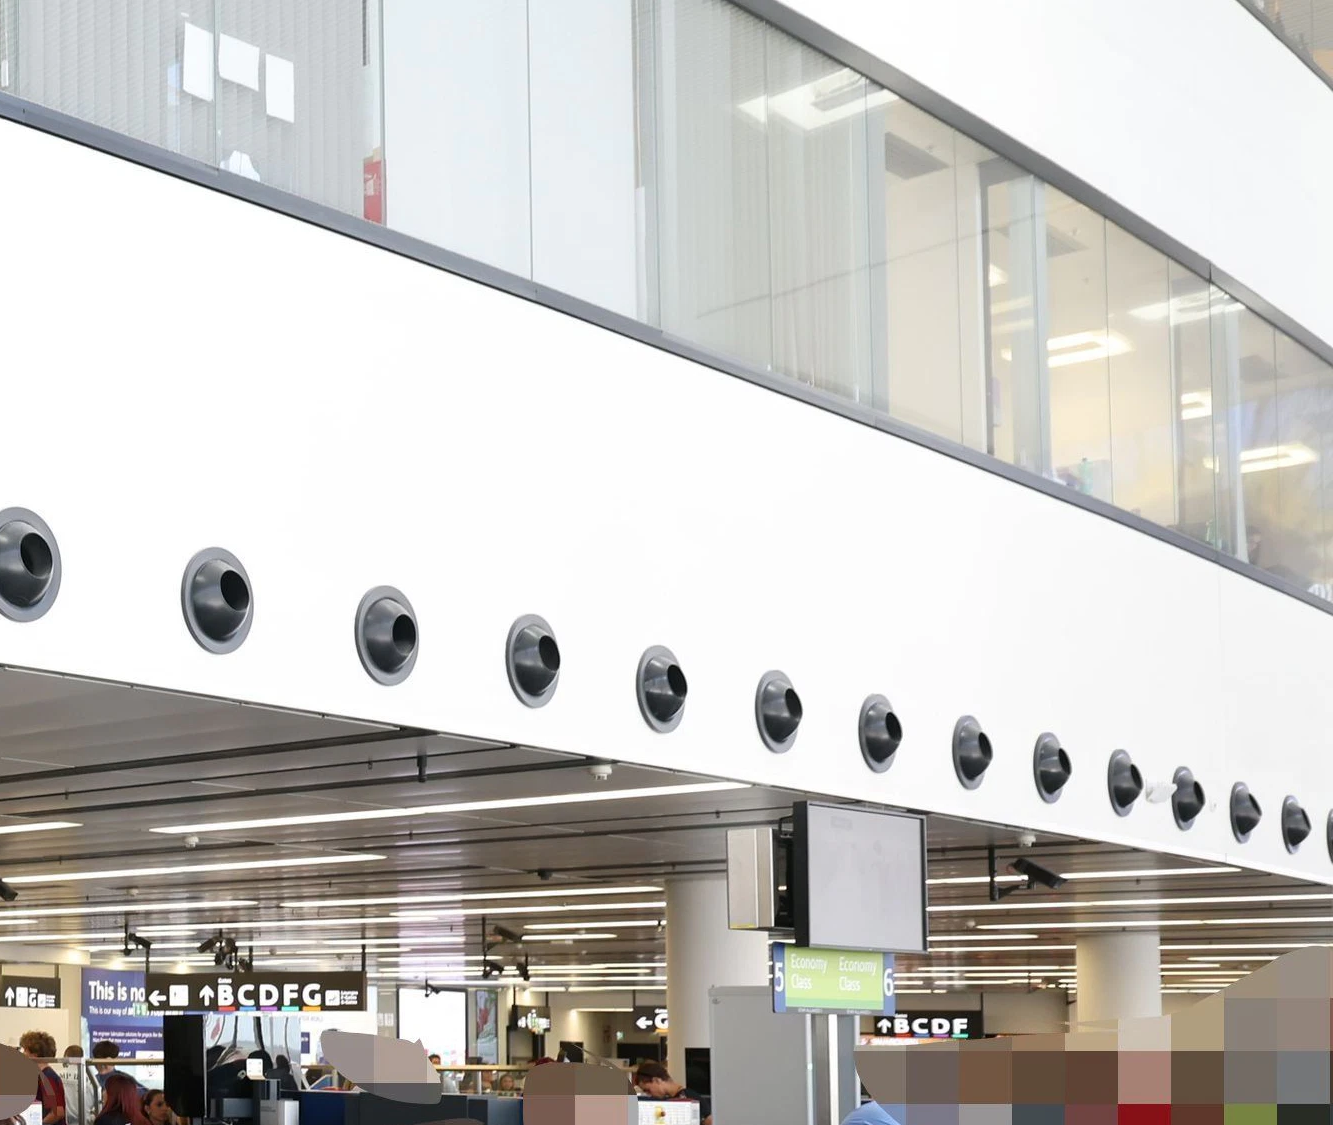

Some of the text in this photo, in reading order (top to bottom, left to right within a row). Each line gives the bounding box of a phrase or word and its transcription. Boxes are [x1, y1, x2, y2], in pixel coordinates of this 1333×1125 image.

[791, 954, 829, 974] Economy
[838, 956, 878, 976] Economy
[775, 962, 784, 992] 5
[792, 973, 813, 990] Class
[838, 976, 861, 992] Class
[884, 968, 894, 997] 6
[88, 980, 115, 1001] This
[117, 981, 128, 1002] is
